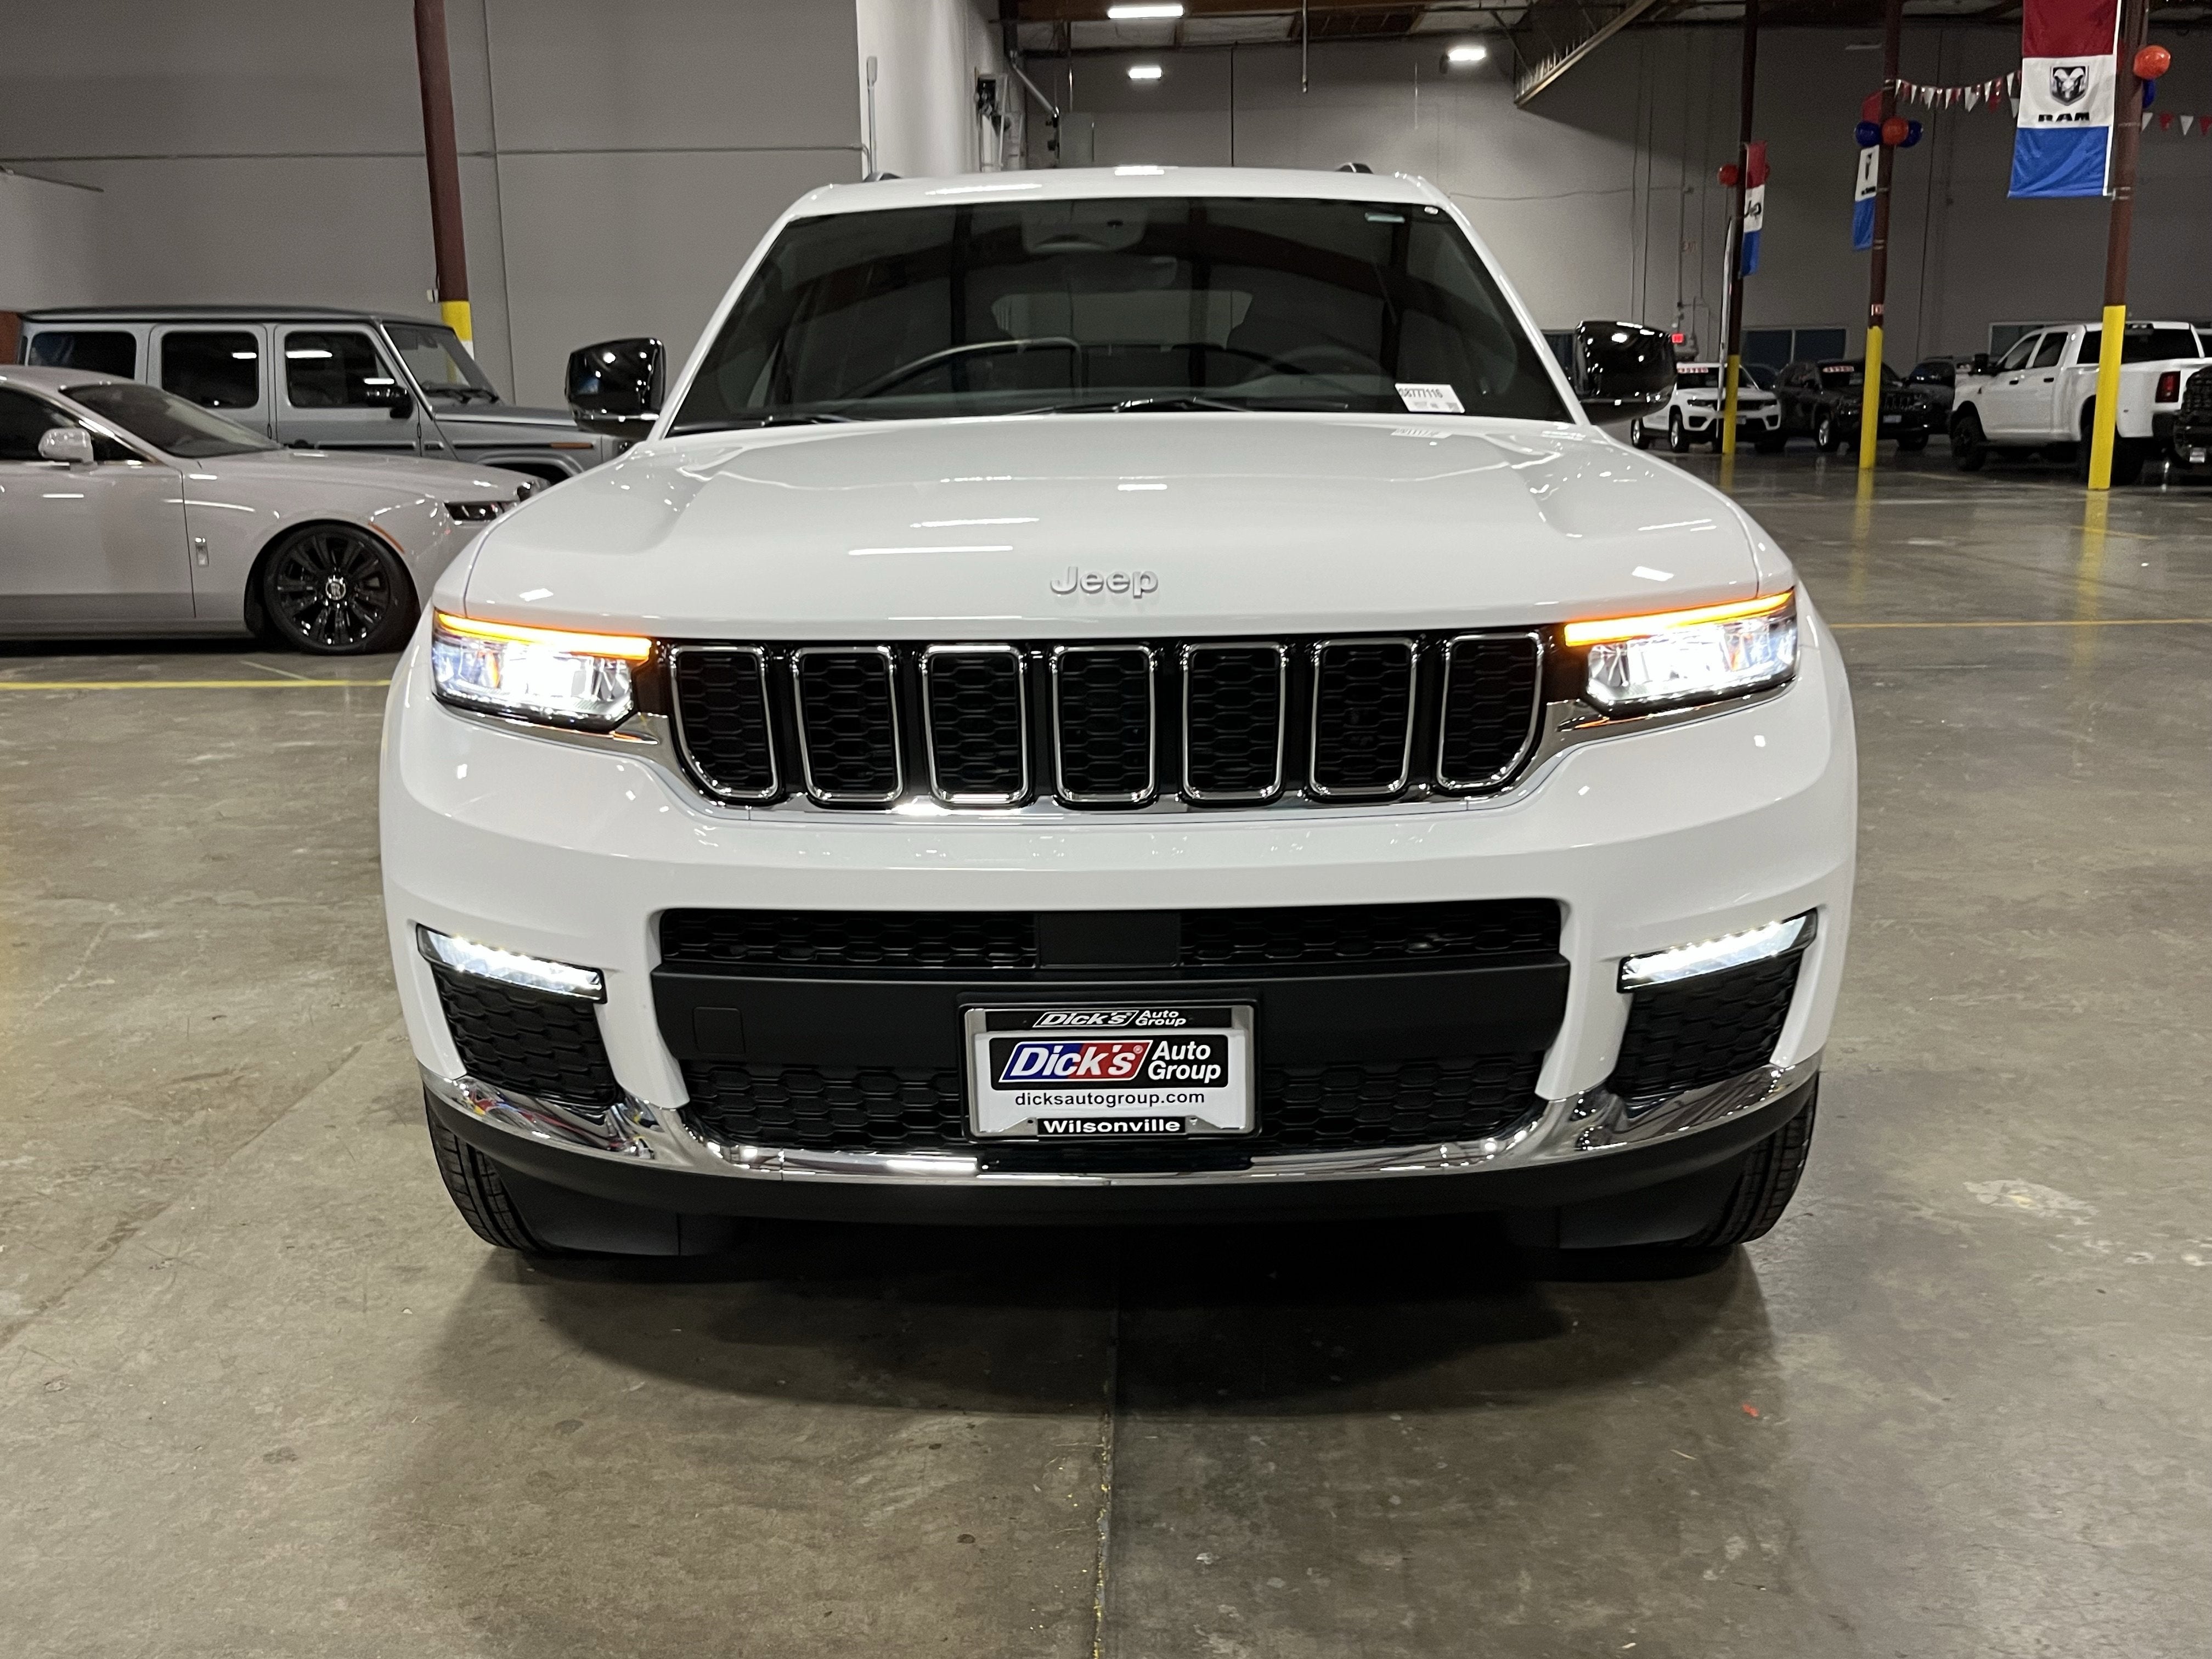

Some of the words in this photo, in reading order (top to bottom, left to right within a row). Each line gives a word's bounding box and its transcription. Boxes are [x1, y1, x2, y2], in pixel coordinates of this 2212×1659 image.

[2038, 112, 2090, 122] RAM
[1050, 566, 1158, 599] Jeep
[1041, 1012, 1127, 1025] Dick's
[1139, 1010, 1179, 1018] Auto
[1135, 1017, 1186, 1026] Group
[1153, 1041, 1211, 1060] Auto
[1010, 1045, 1135, 1076] Dick's
[1148, 1060, 1221, 1083] Group
[1015, 1092, 1205, 1107] dicksautogroup.com
[1043, 1120, 1180, 1133] Wilsonville
